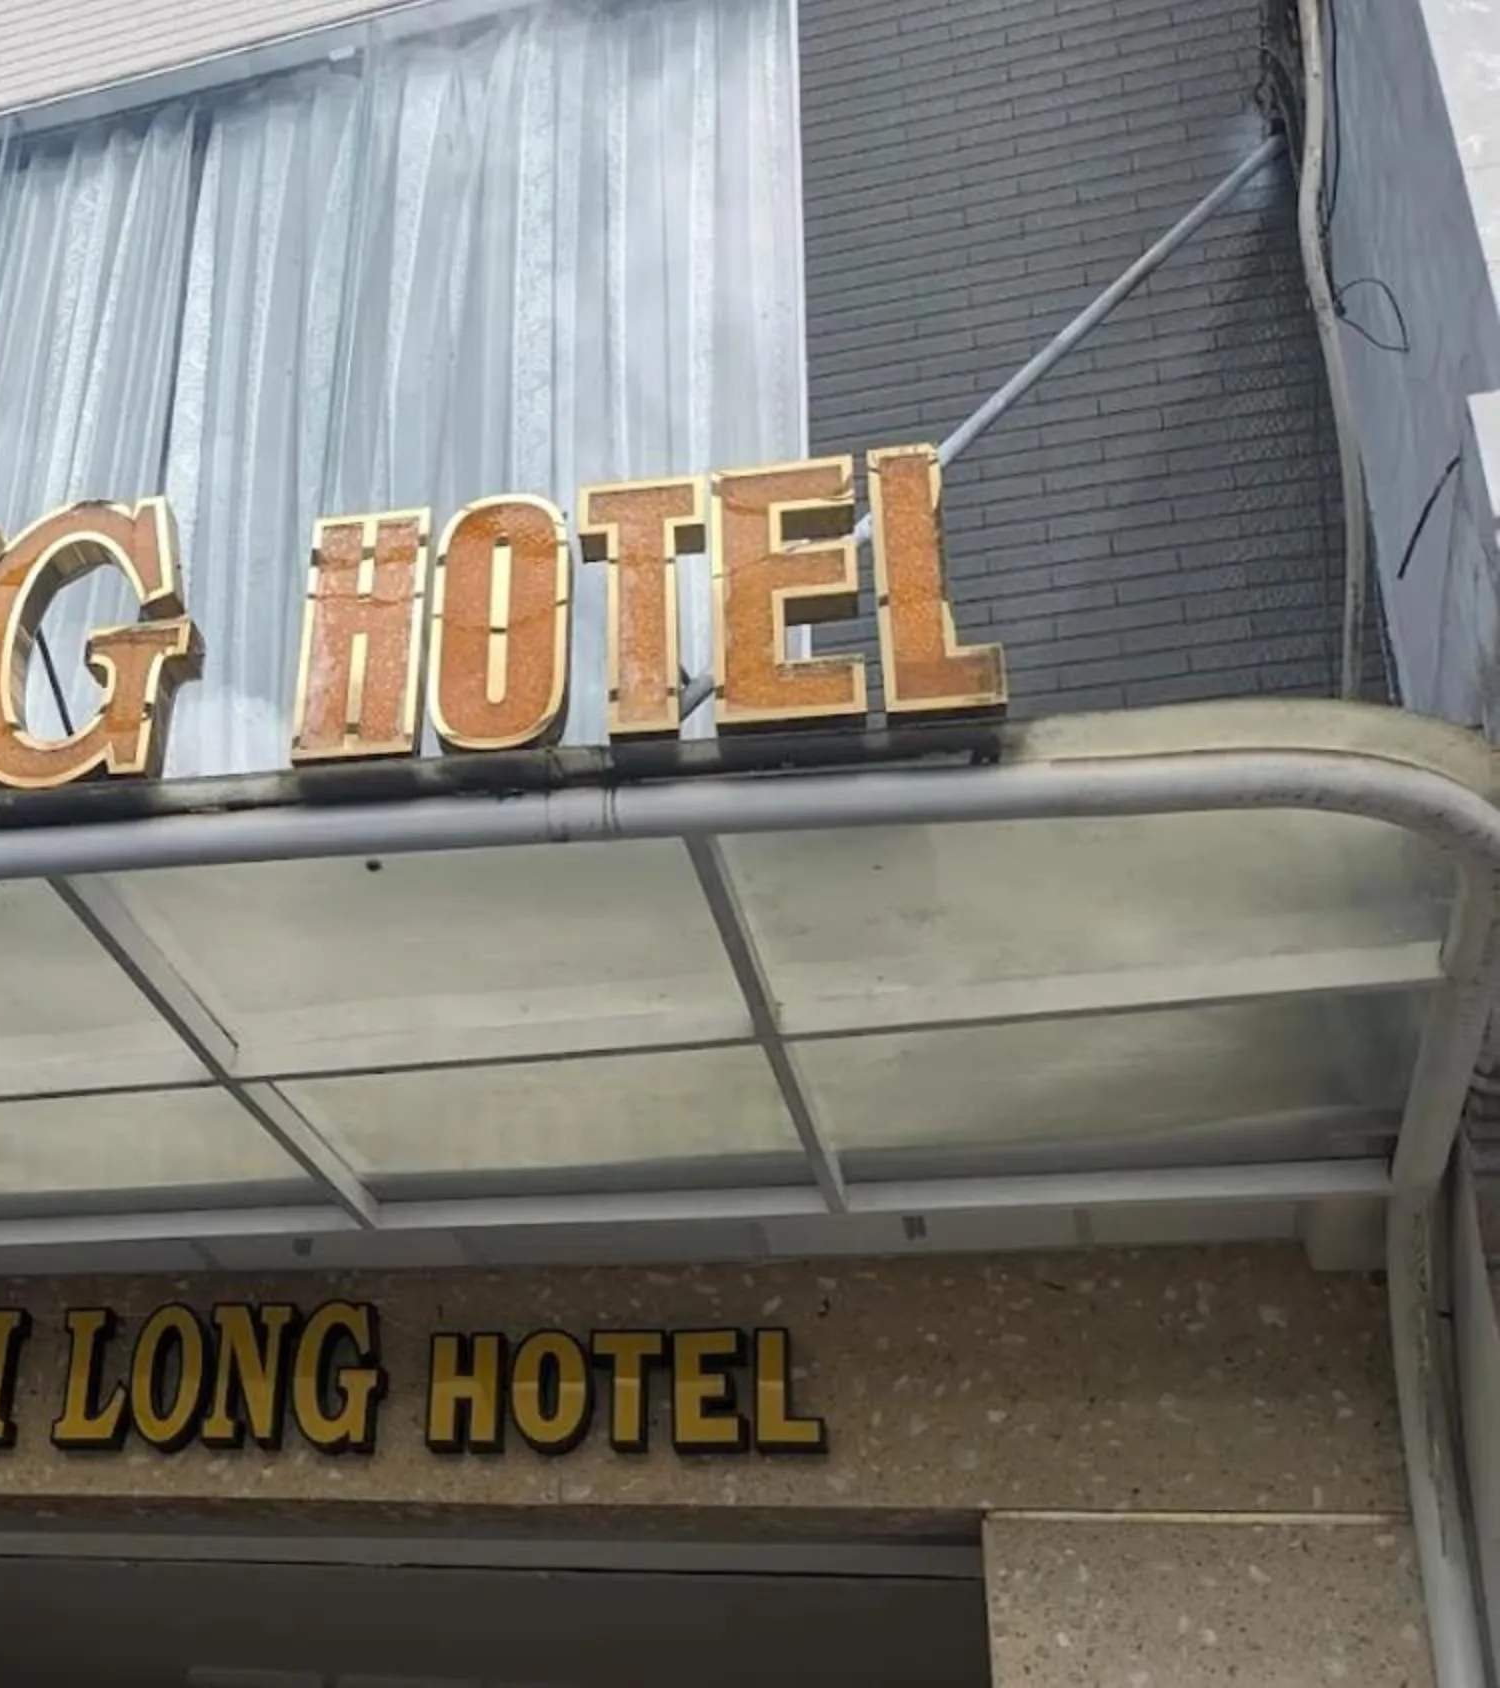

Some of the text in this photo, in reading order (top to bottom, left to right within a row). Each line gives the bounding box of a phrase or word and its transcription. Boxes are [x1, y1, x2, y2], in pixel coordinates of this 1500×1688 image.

[291, 442, 1008, 766] HOTEL
[52, 1299, 384, 1453] LONG
[425, 1326, 827, 1454] HOTEL
